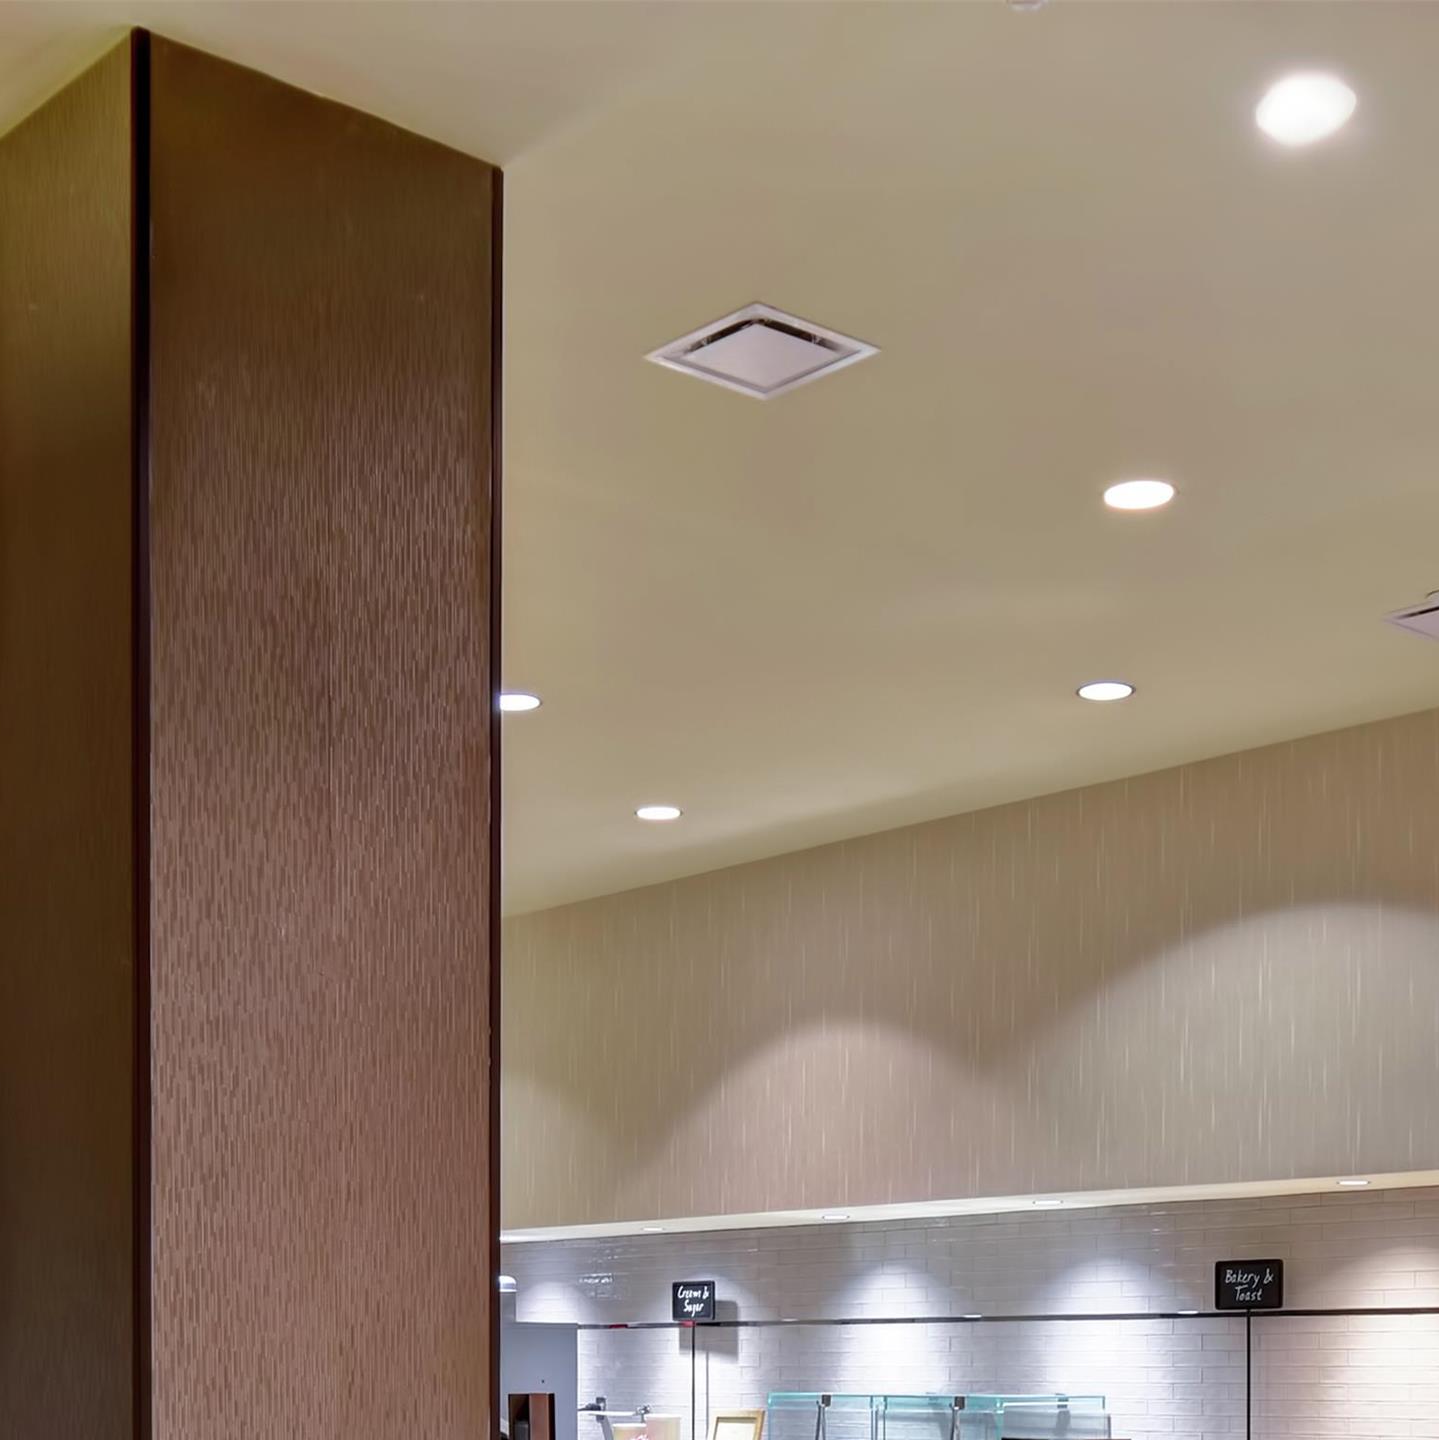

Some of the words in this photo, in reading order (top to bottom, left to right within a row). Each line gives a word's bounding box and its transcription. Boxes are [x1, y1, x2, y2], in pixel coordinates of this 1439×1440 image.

[1225, 1269, 1260, 1289] Bakery
[1235, 1284, 1262, 1301] Toast
[683, 1299, 704, 1318] Sugar
